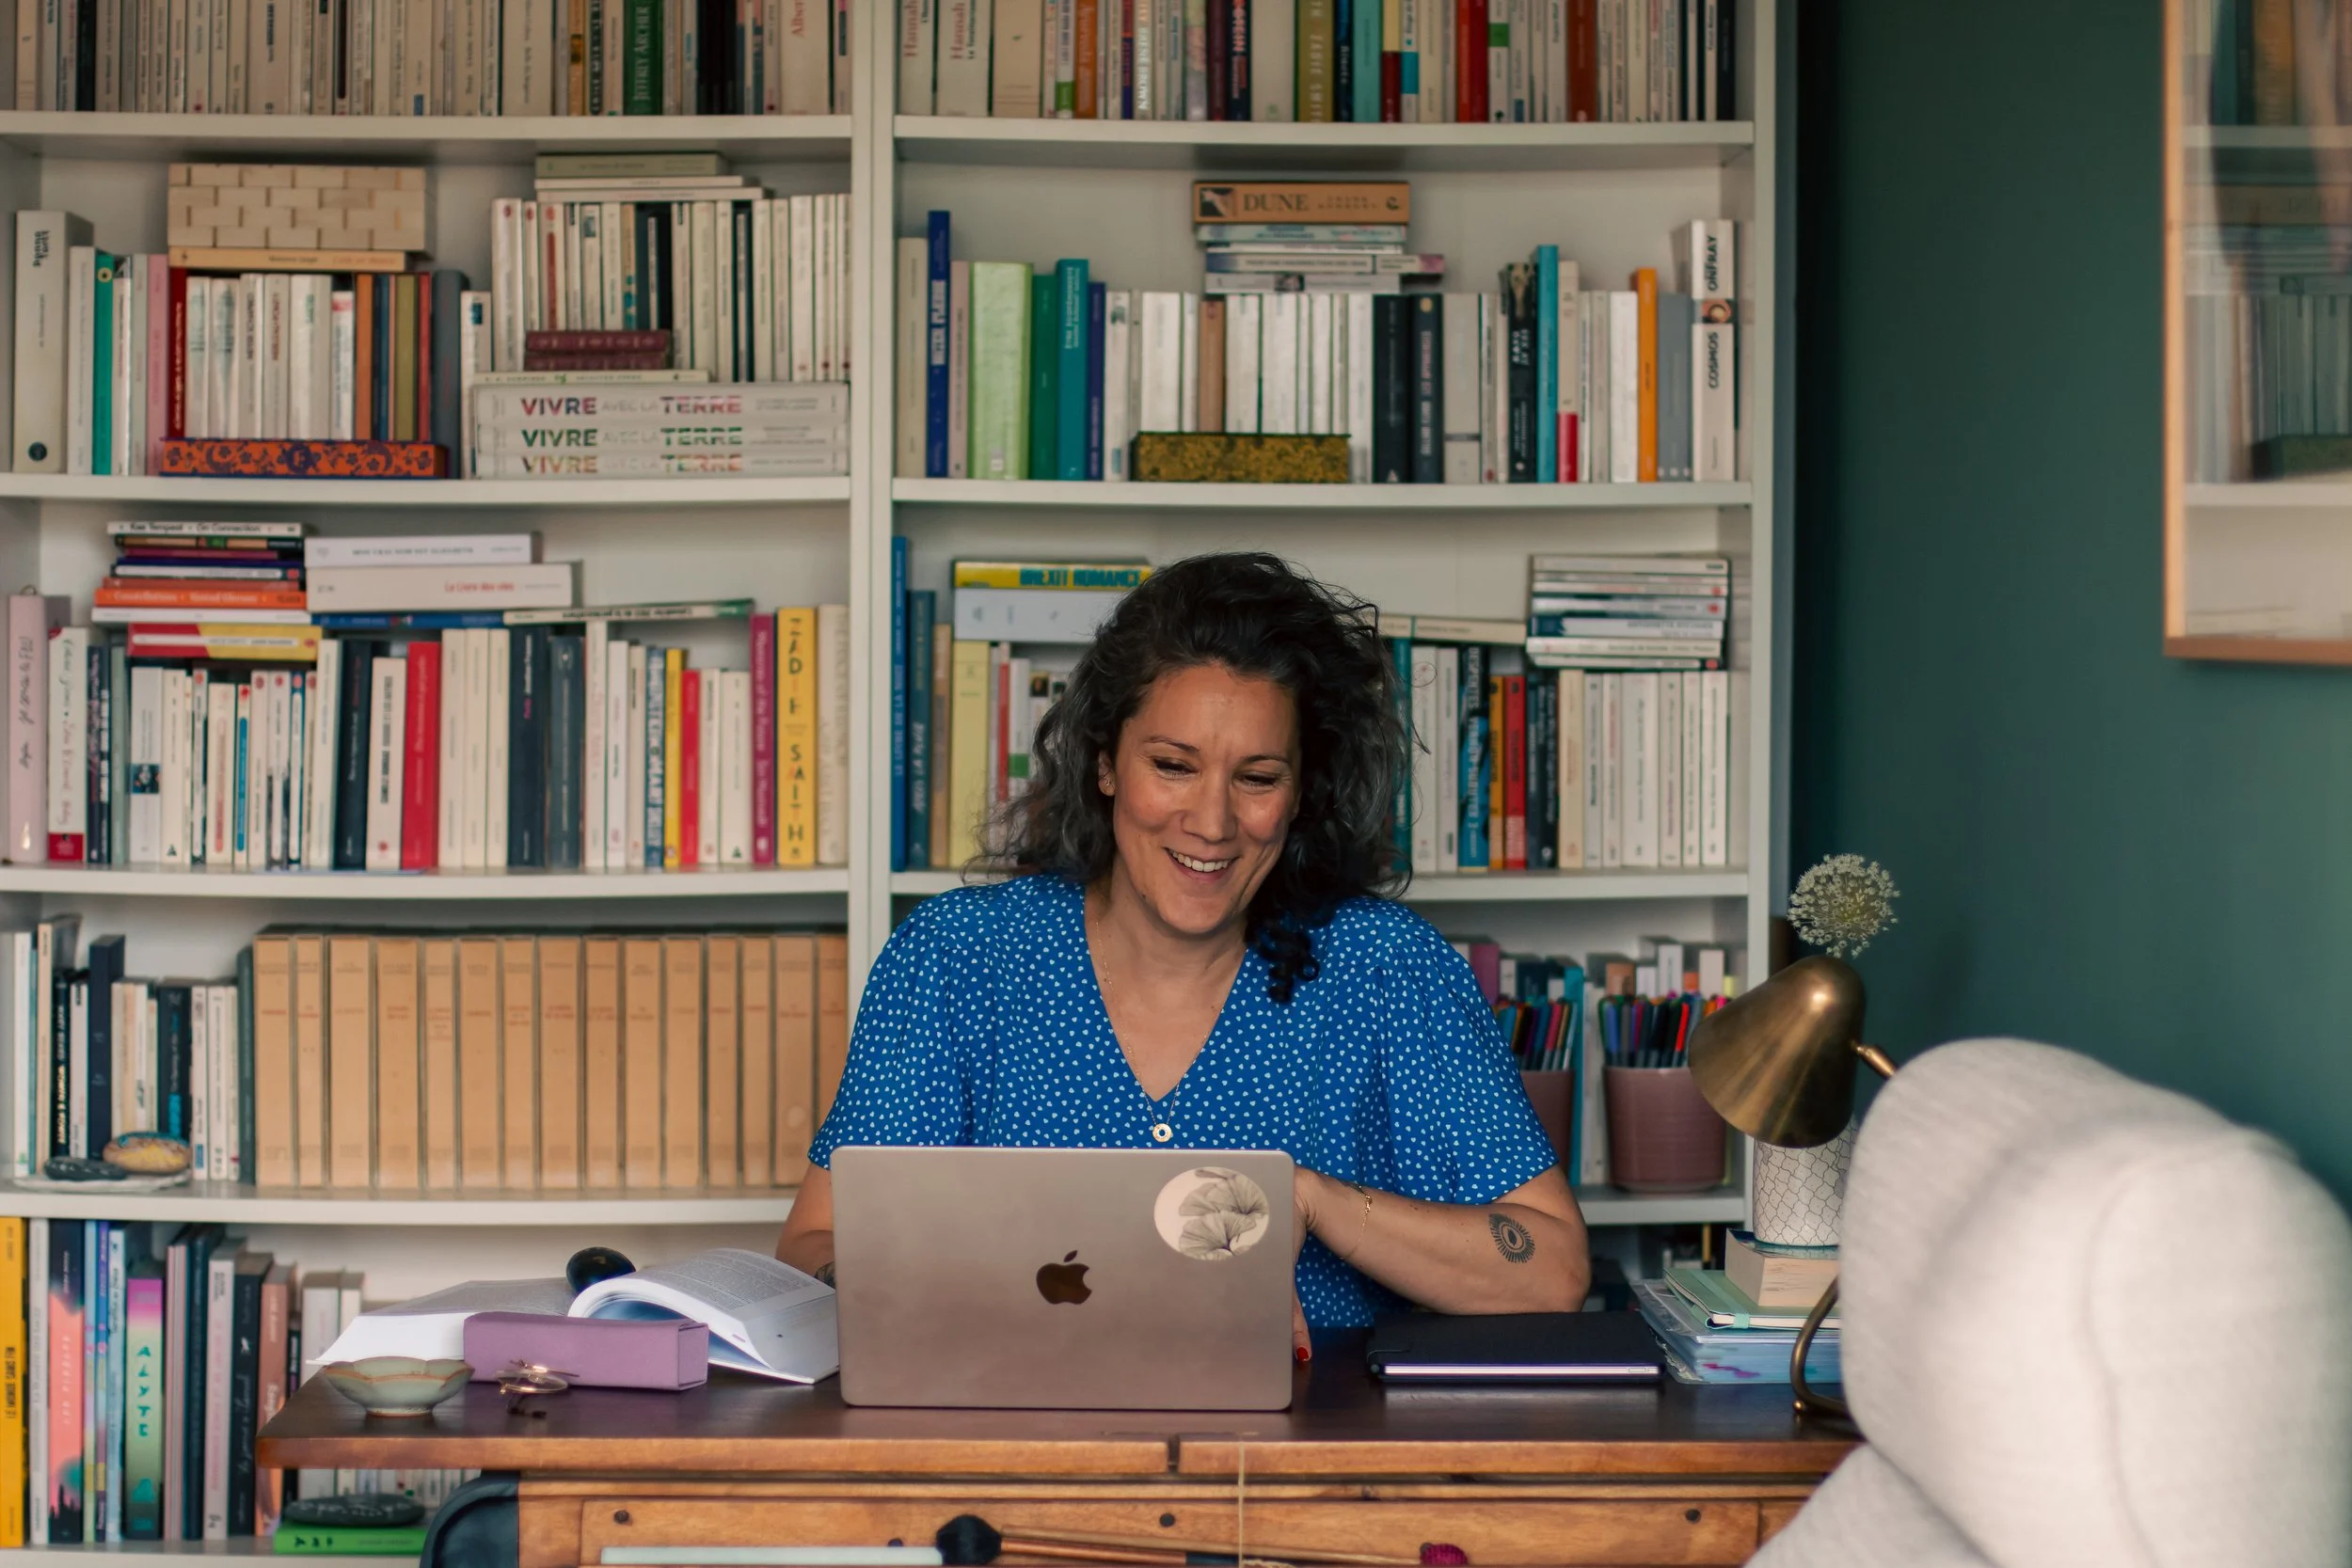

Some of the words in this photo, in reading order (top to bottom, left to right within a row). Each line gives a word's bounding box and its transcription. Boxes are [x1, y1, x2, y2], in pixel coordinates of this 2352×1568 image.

[633, 6, 649, 53] ARCHER
[791, 0, 805, 38] Alber
[950, 3, 964, 59] Hannah
[633, 58, 649, 101] JEFFREY
[1244, 194, 1309, 212] DUNE
[1707, 235, 1719, 291] ONFRAY
[1708, 332, 1720, 388] COSMOS
[520, 397, 597, 416] VIVRE
[660, 396, 741, 415] TERRE
[521, 428, 598, 447] VIVRE
[660, 427, 742, 446] TERRE
[521, 455, 598, 474] VIVRE
[660, 454, 742, 474] TERRE
[1468, 646, 1479, 708] DESPENTES
[5, 1359, 16, 1379] SANS
[5, 1383, 16, 1408] MONDE
